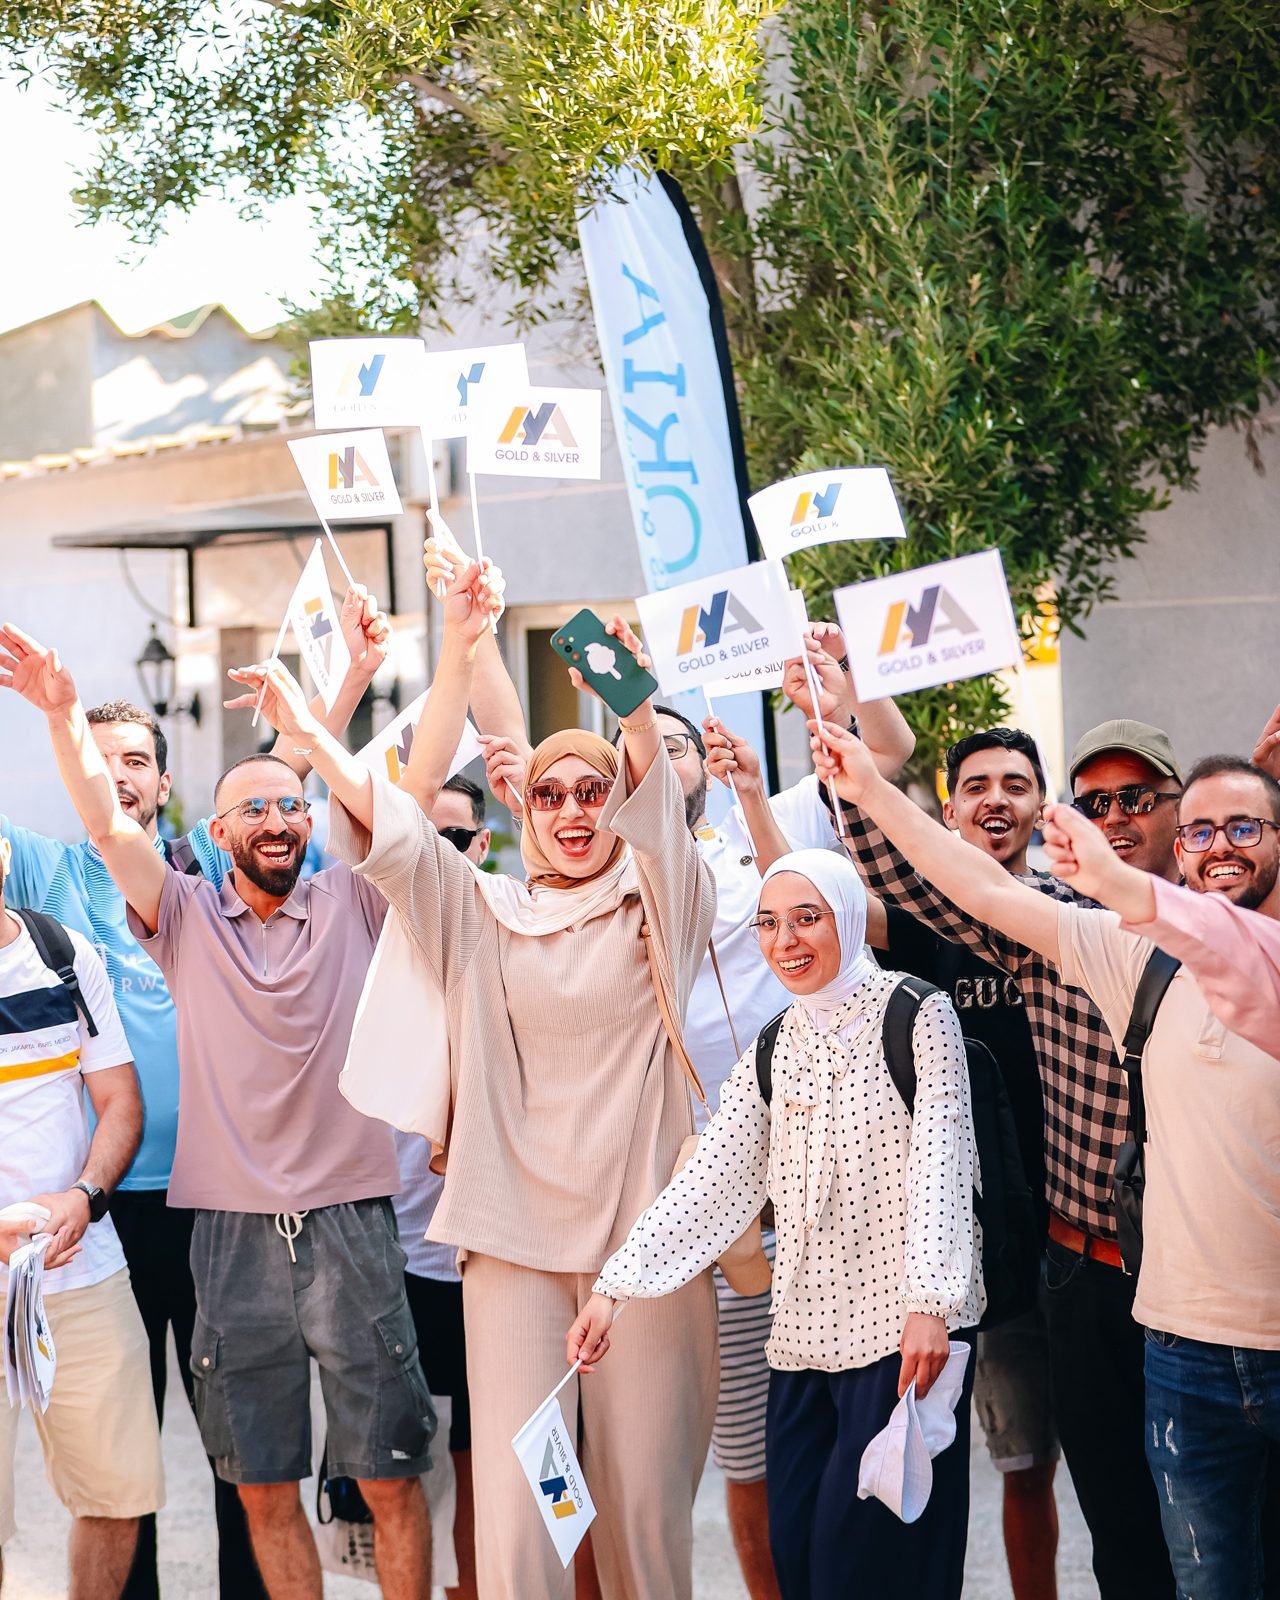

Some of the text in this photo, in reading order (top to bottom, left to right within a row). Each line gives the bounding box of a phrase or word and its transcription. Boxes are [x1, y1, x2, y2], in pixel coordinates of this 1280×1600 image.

[495, 450, 580, 464] GOLD & SILVER
[330, 491, 385, 505] GOLD & SILVER
[790, 522, 827, 538] GOLD
[678, 636, 770, 673] GOLD & SILVER
[878, 638, 986, 677] GOLD & SILVER
[764, 661, 784, 675] SILV
[955, 975, 1023, 1009] GUC
[551, 1426, 583, 1509] GOLD & SILVER
